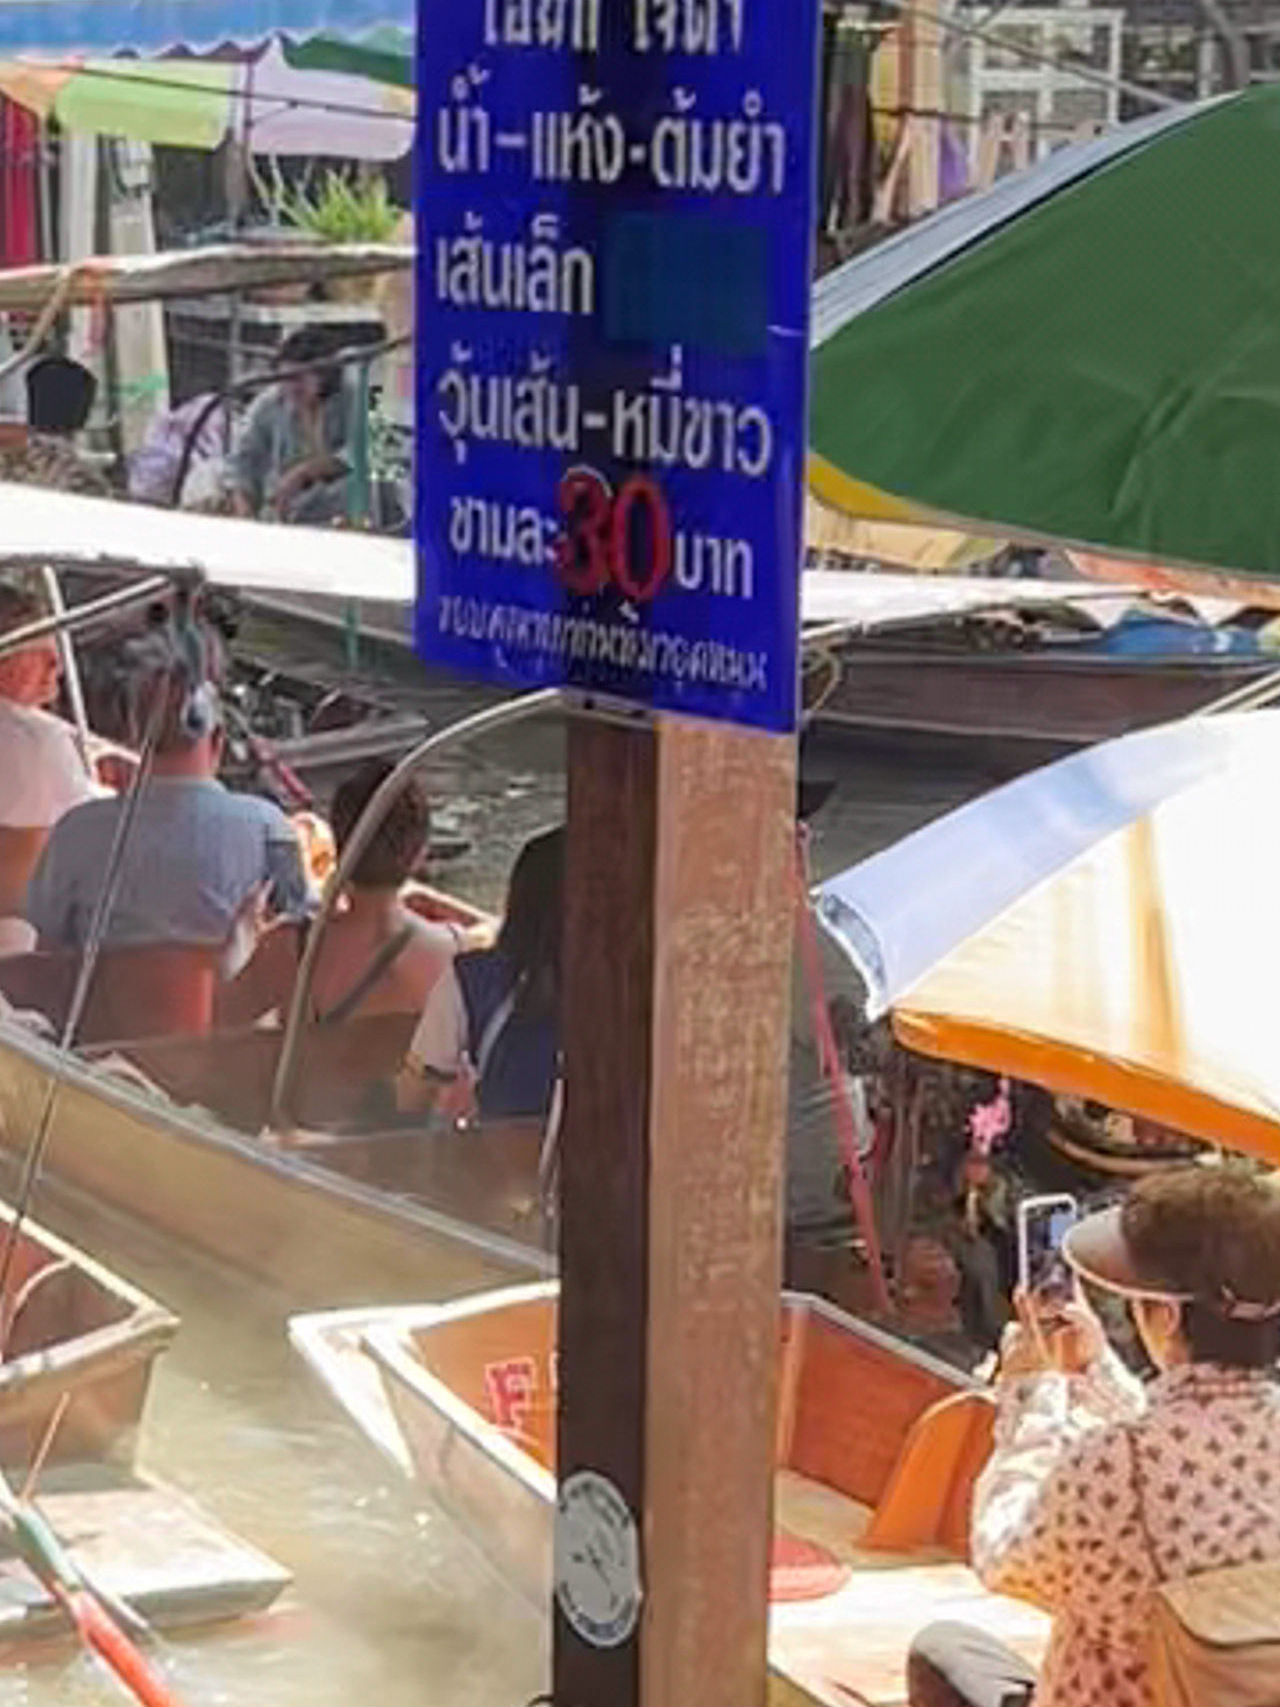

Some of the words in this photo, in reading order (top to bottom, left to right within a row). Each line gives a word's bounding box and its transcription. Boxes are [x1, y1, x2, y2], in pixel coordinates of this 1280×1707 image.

[436, 211, 594, 315] เส้นเล็ก
[437, 340, 773, 477] วุ้นเส้น-หมี่ขาว
[675, 531, 754, 599] บาท
